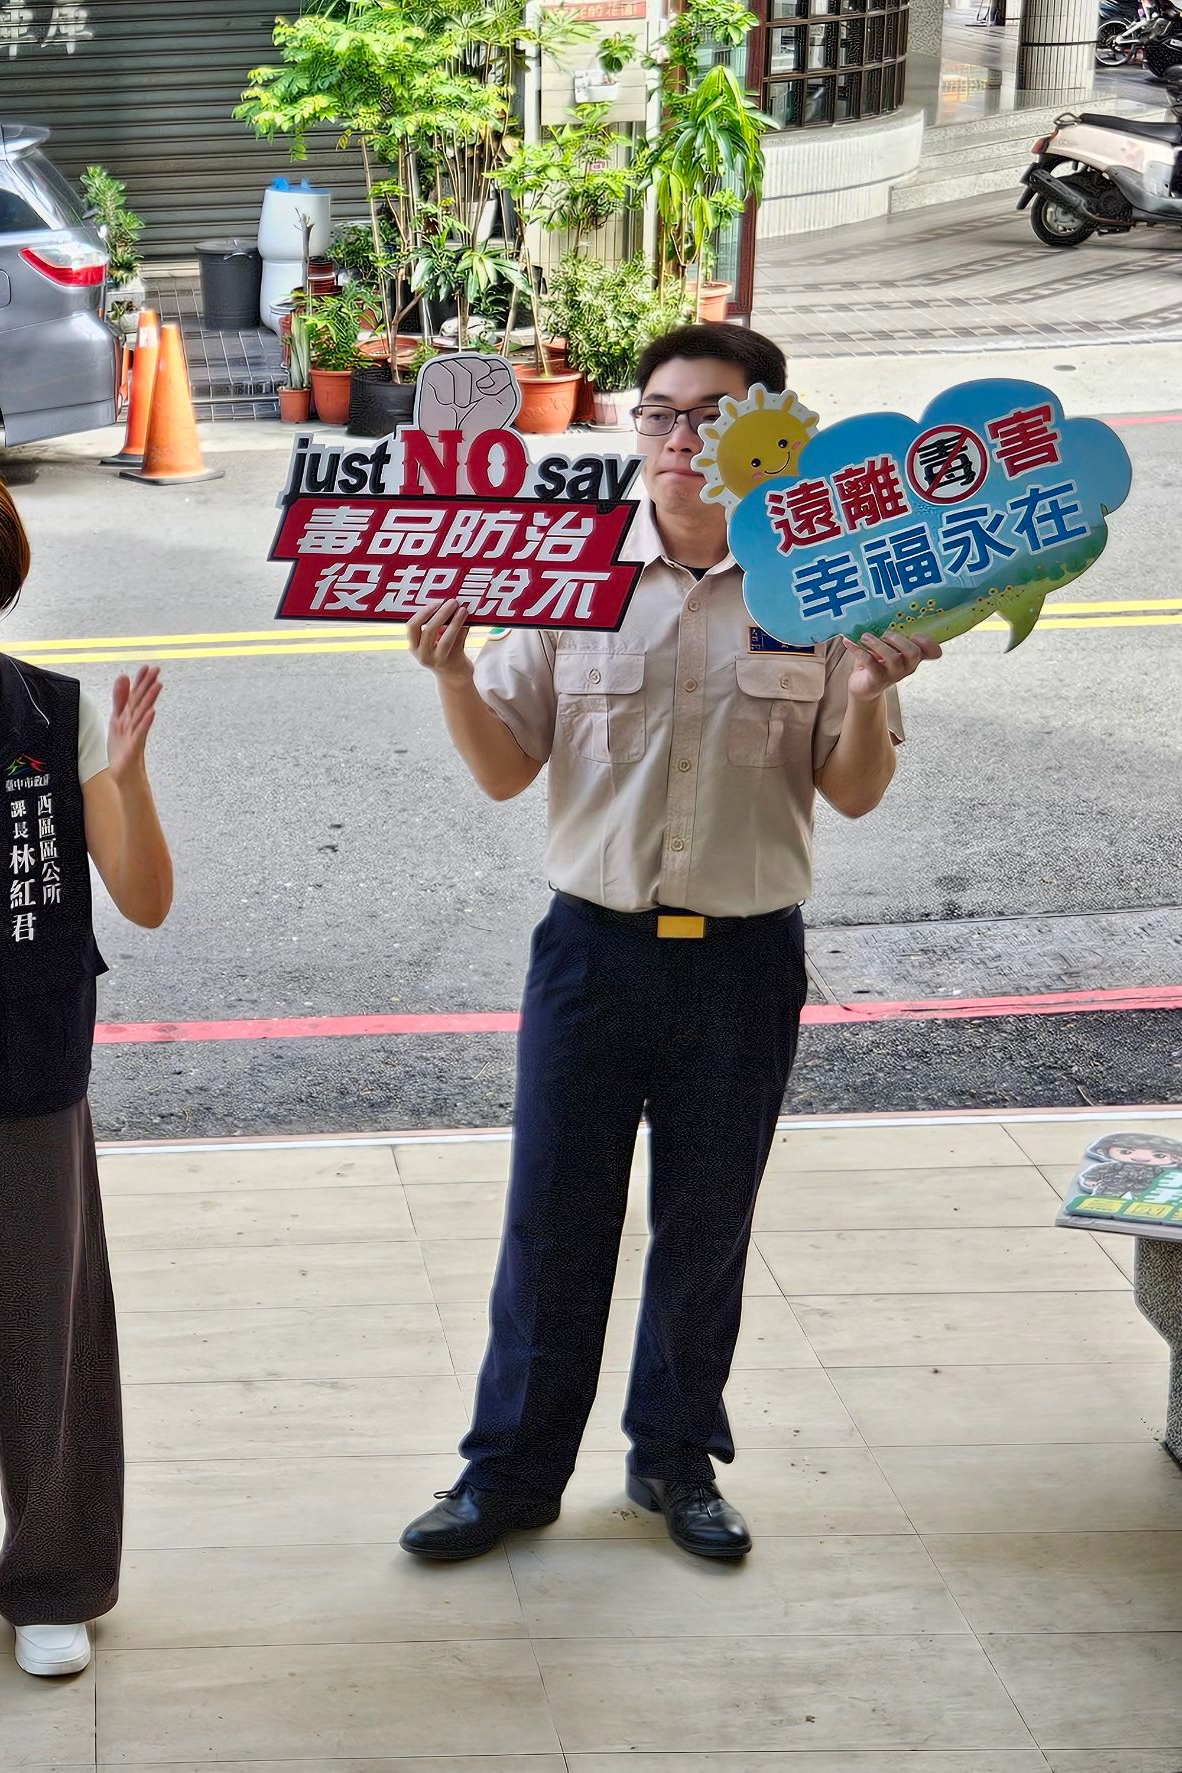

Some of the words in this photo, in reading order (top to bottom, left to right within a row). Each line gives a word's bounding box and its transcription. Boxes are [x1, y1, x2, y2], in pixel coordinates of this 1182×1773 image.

[283, 436, 392, 505] just
[400, 429, 530, 496] NO
[533, 455, 644, 513] say
[296, 505, 595, 562] 毒品防治
[766, 404, 1061, 554] 遠離毒害
[793, 482, 1088, 620] 幸福永在
[9, 799, 37, 942] 課長林紅君
[37, 792, 62, 906] 西區區公所
